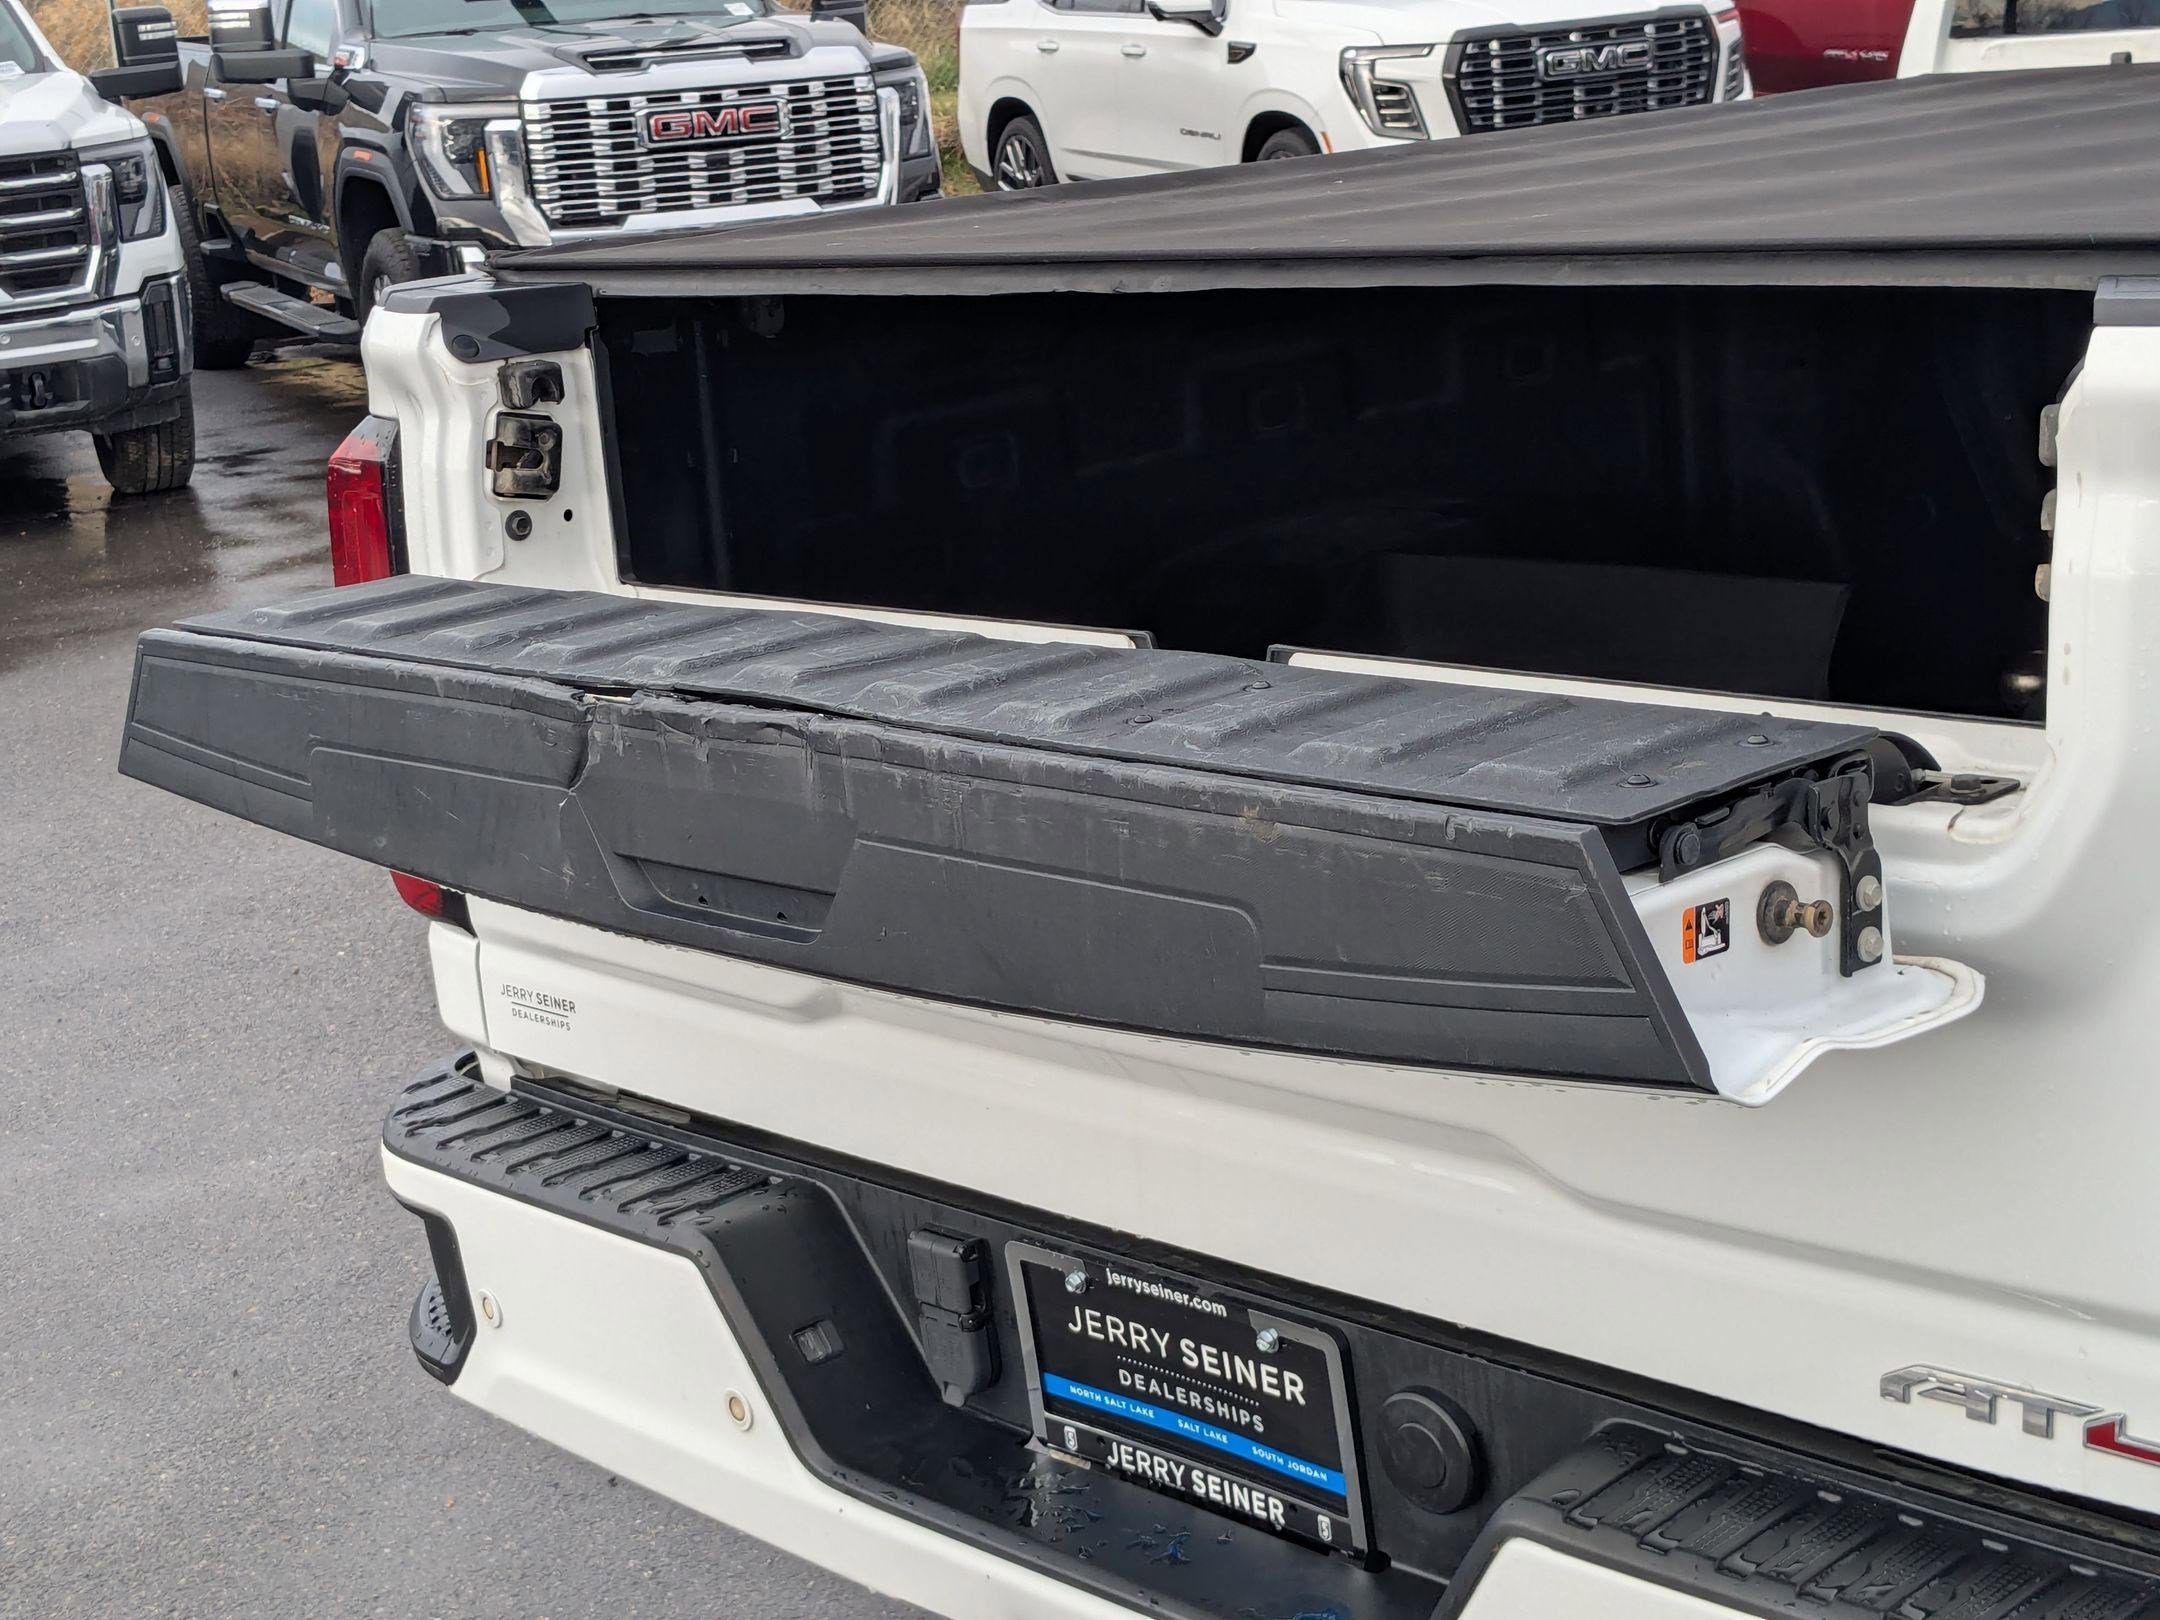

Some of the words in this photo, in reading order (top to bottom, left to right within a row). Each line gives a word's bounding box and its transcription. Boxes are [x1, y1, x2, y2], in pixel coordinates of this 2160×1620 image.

[1546, 43, 1650, 76] GMC
[650, 104, 779, 141] GMC
[500, 983, 534, 1002] JERRY
[535, 992, 577, 1014] SEINER
[511, 1007, 571, 1031] DEALERSHIPS
[1106, 1268, 1228, 1318] jerryseiner.com
[1068, 1305, 1171, 1359] JERRY
[1179, 1337, 1307, 1406] SEINER
[1069, 1385, 1102, 1402] NORTH
[1103, 1396, 1127, 1410] SALT
[1129, 1403, 1155, 1419] LAKE
[1118, 1368, 1265, 1433] DEALERSHIPS
[1177, 1418, 1200, 1433] SALT
[1203, 1428, 1229, 1444] LAKE
[1251, 1446, 1285, 1466] SOUTH
[1287, 1460, 1328, 1482] JORDAN
[1107, 1441, 1186, 1488] JERRY
[1191, 1469, 1286, 1529] SEINER
